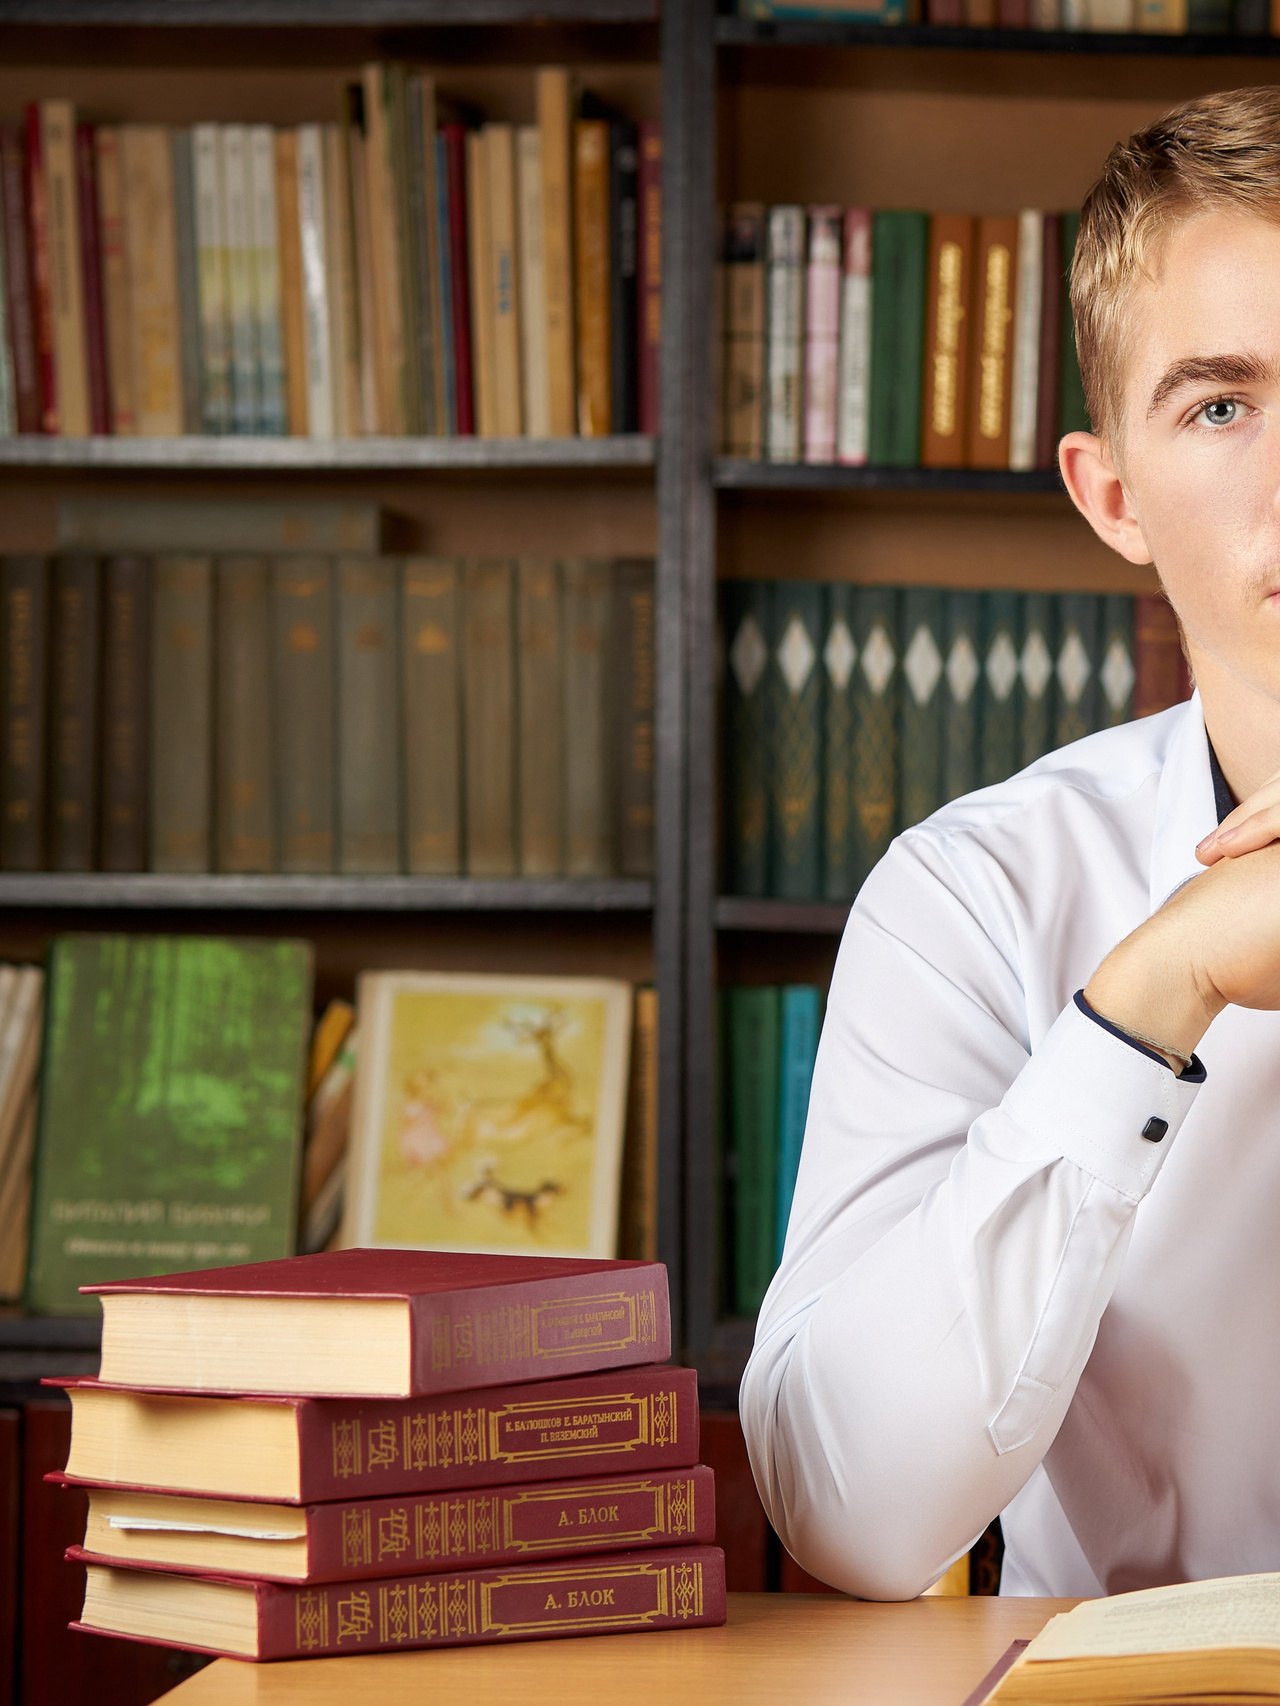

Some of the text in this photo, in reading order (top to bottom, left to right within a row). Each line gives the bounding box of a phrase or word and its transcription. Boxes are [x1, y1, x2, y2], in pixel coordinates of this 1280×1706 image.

[505, 1407, 633, 1432] К. БАТЮШКОВ Е. БАРАТЫНСКИЙ
[540, 1424, 598, 1443] П. ВЯЗЕМСКИЙ
[558, 1505, 619, 1527] А. БЛОК
[544, 1588, 615, 1610] А. БЛОК
